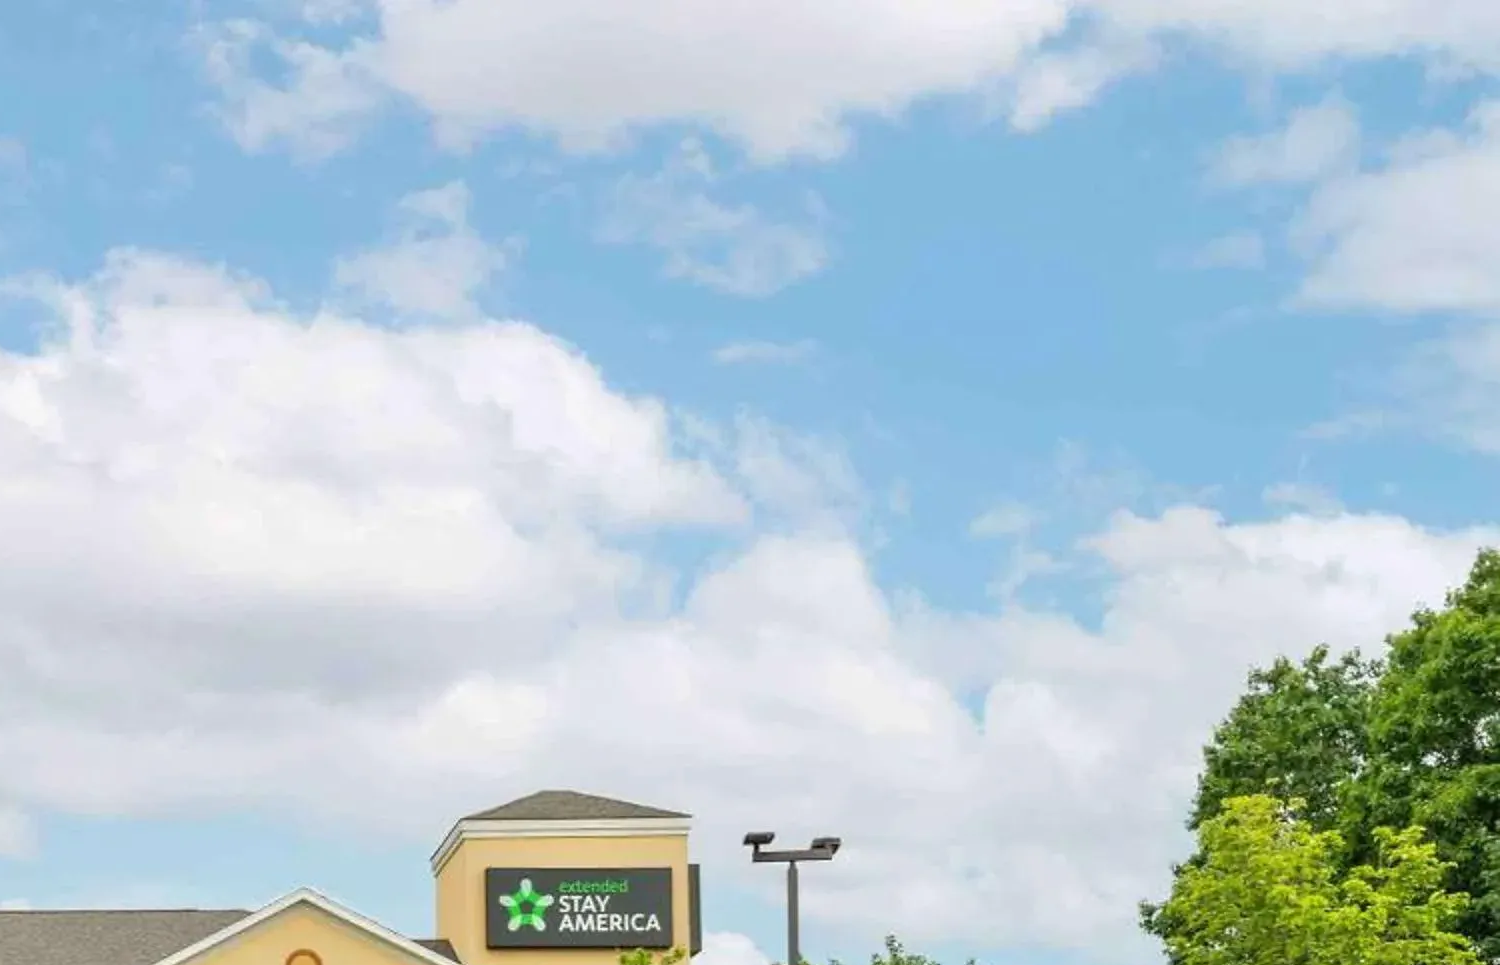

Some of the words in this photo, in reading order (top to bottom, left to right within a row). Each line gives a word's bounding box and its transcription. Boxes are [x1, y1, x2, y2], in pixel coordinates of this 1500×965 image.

[558, 879, 628, 893] extended
[558, 895, 610, 912] STAY
[558, 913, 661, 932] AMERICA
